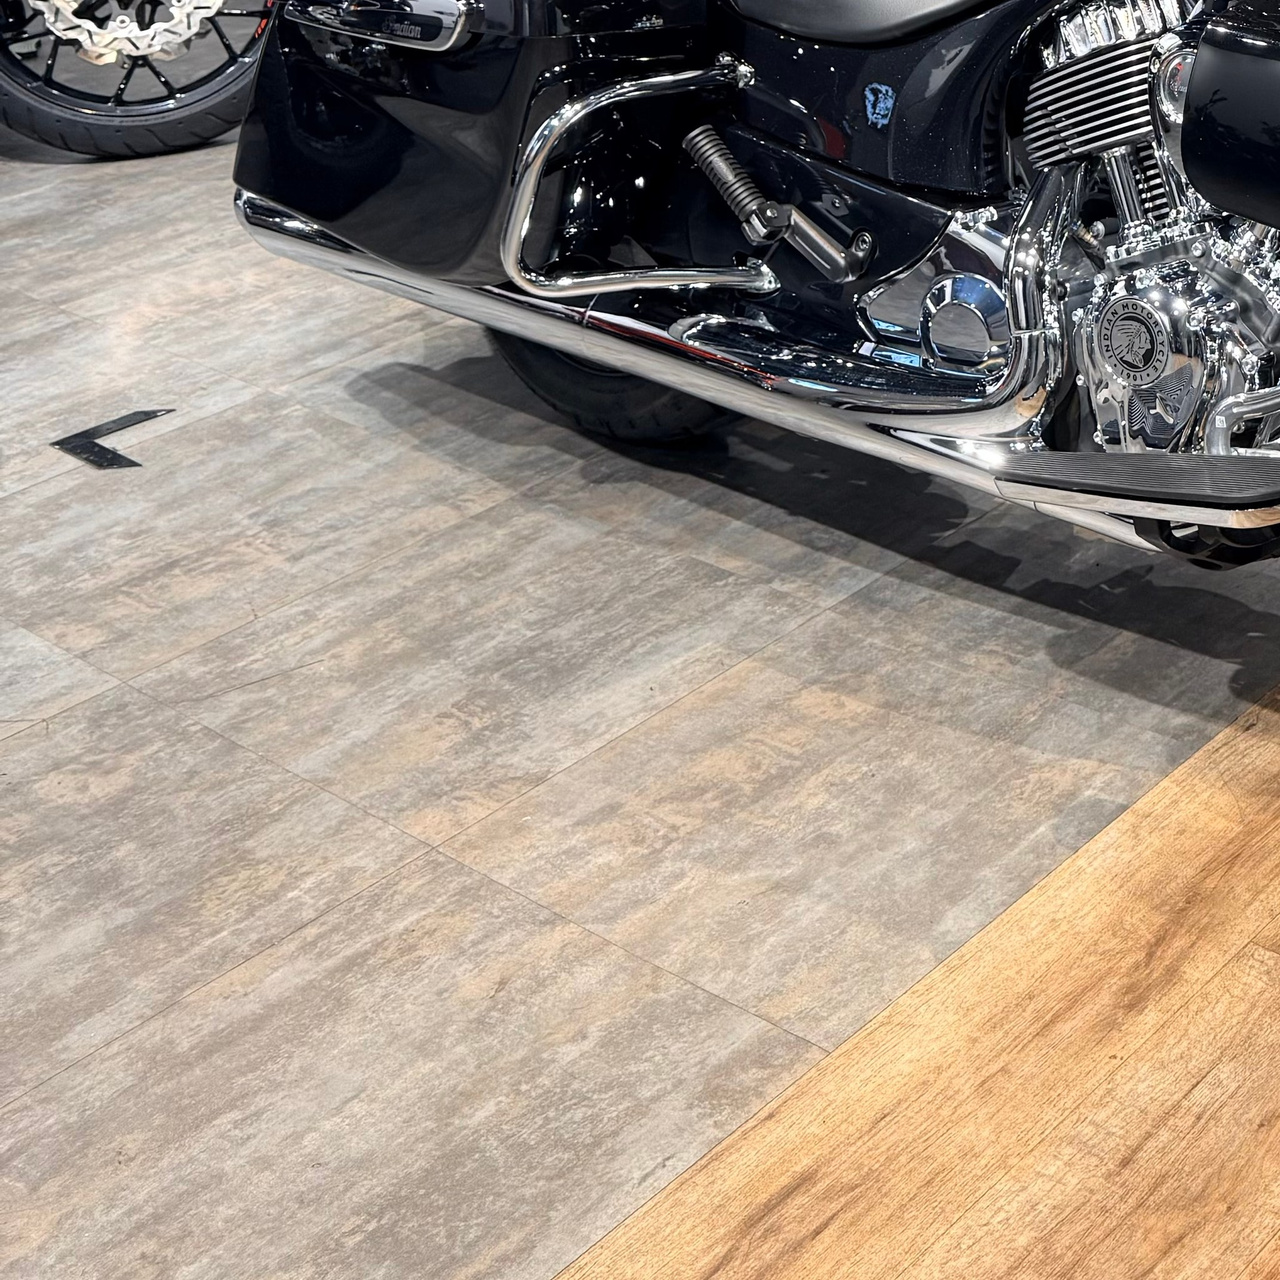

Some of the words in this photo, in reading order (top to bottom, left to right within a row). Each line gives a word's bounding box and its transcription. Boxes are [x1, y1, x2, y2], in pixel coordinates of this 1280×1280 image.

[381, 15, 422, 39] Indian
[1103, 309, 1119, 359] INDIAN
[1121, 303, 1165, 373] MOTORCYCLE
[1120, 369, 1143, 381] 1901
